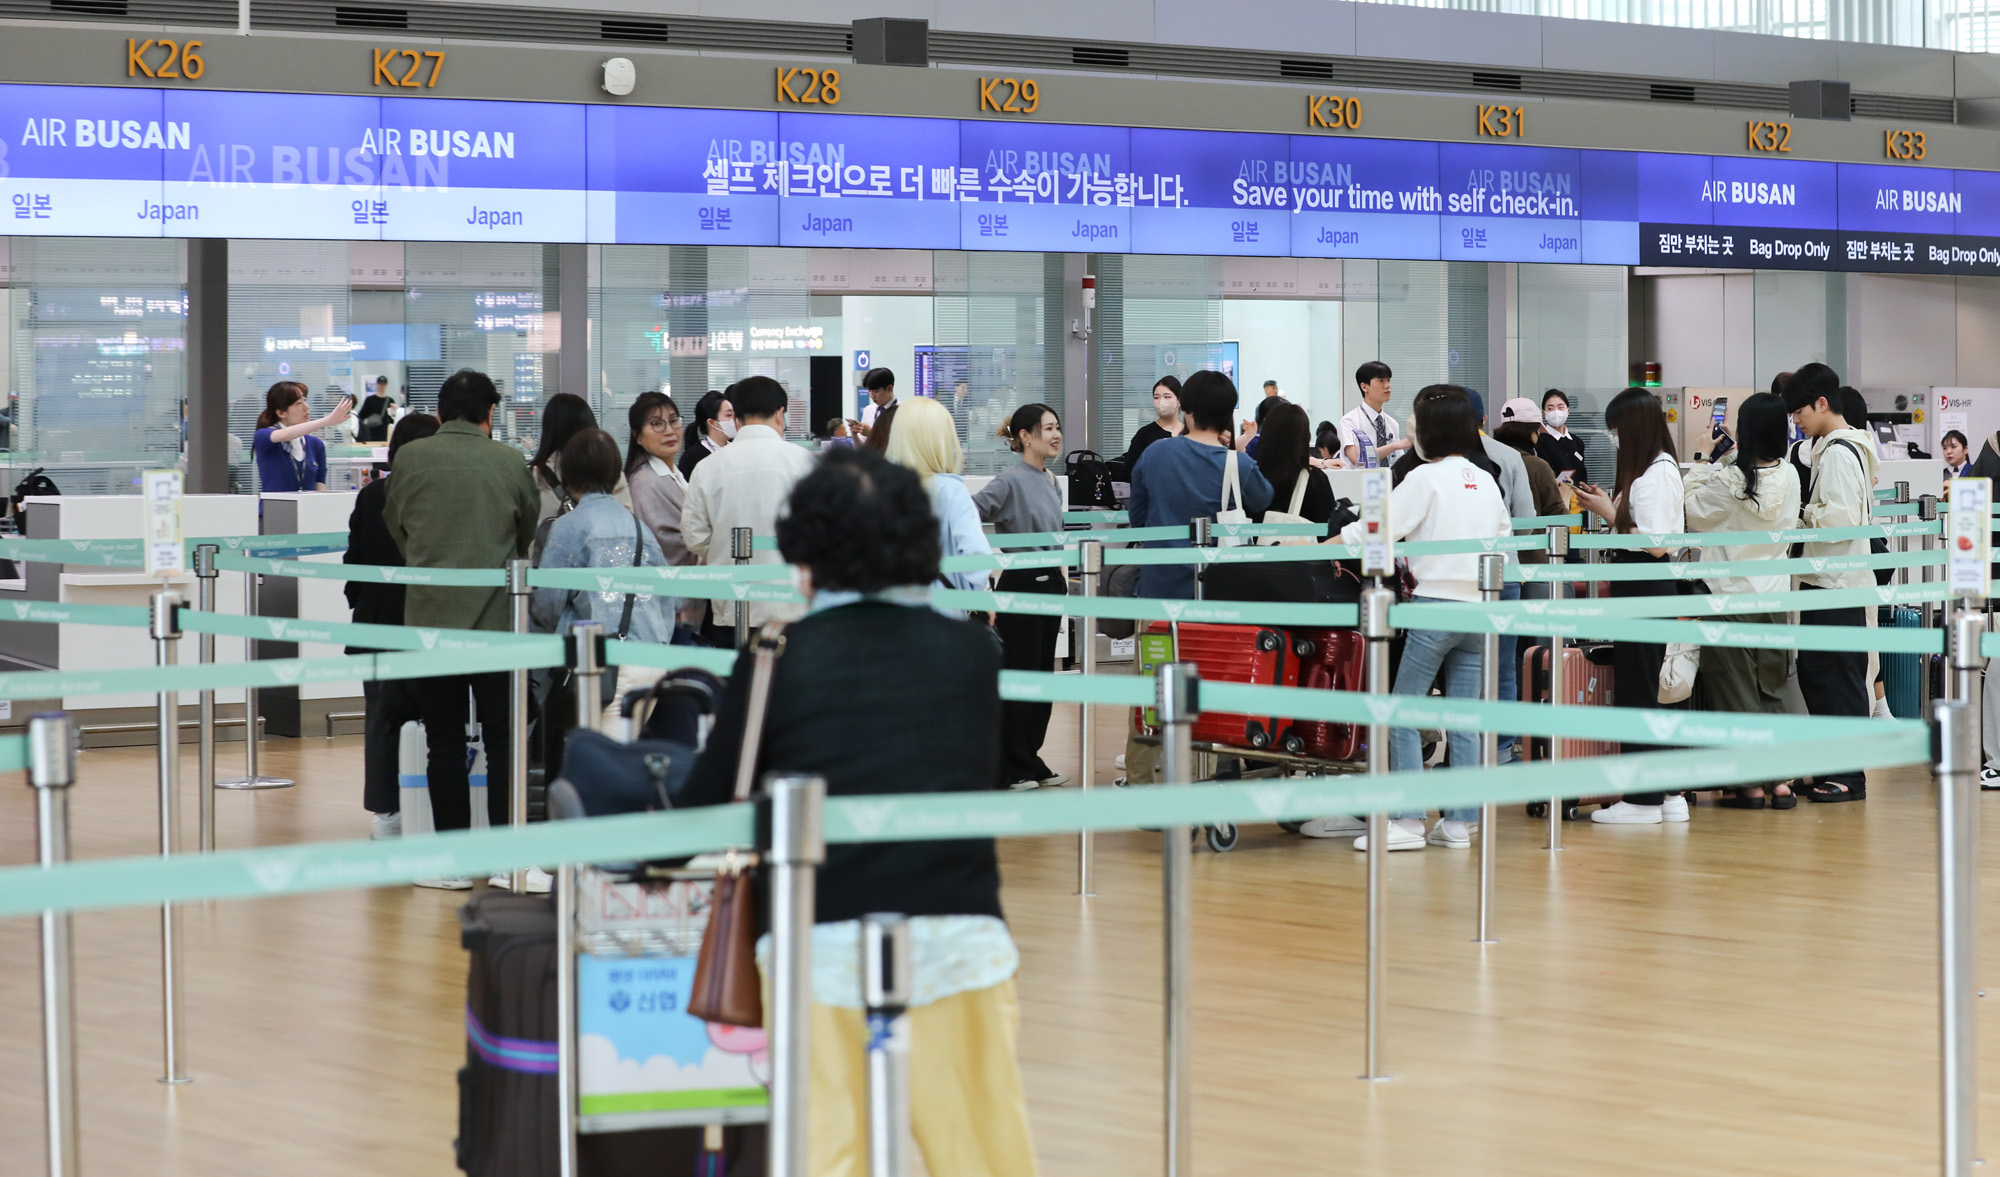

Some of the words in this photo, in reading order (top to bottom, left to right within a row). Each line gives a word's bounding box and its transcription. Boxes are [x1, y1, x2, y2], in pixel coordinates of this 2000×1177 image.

[126, 39, 205, 80] K26
[371, 48, 446, 88] K27
[776, 67, 841, 105] K28
[979, 77, 1040, 114] K29
[1307, 95, 1363, 130] K30
[1477, 104, 1525, 138] K31
[21, 117, 66, 147] AIR
[75, 119, 191, 150] BUSAN
[360, 127, 402, 156] AIR
[409, 129, 514, 158] BUSAN
[1747, 121, 1792, 154] K32
[1885, 129, 1927, 161] K33
[750, 139, 845, 168] BUSAN
[1024, 151, 1111, 177] BUSAN
[702, 159, 757, 196] 셀프
[762, 160, 894, 198] 체크인으로
[901, 164, 924, 201] 더
[932, 166, 982, 202] 빠른
[988, 168, 1060, 205] 수속이
[1067, 170, 1189, 208] 가능합니다.
[1238, 159, 1269, 184] AIR
[1274, 161, 1352, 186] BUSAN
[1467, 169, 1495, 193] AIR
[1500, 171, 1571, 195] BUSAN
[12, 193, 52, 219] 일본
[1232, 178, 1288, 208] Save
[1292, 185, 1344, 213] your
[1347, 183, 1394, 211] time
[1398, 185, 1442, 212] with
[1447, 188, 1485, 214] self
[1489, 190, 1580, 217] check-in.
[1702, 179, 1728, 204] AIR
[1732, 182, 1796, 207] BUSAN
[1875, 188, 1899, 212] AIR
[1902, 191, 1962, 214] BUSAN
[137, 200, 199, 224] Japan
[351, 200, 390, 225] 일본
[467, 206, 523, 229] Japan
[699, 207, 732, 231] 일본
[802, 214, 853, 236] Japan
[978, 214, 1009, 238] 일본
[1072, 220, 1118, 242] Japan
[1231, 220, 1259, 243] 일본
[1317, 227, 1359, 248] Japan
[1461, 227, 1488, 250] 일본
[1539, 233, 1578, 255] Japan
[1658, 234, 1682, 255] 짐만
[1685, 234, 1720, 256] 부치는
[1722, 236, 1735, 257] 곳
[1750, 239, 1770, 261] Bag
[1772, 239, 1800, 261] Drop
[1802, 241, 1830, 262] Only
[1846, 241, 1868, 261] 짐만
[1870, 242, 1901, 262] 부치는
[1903, 242, 1915, 262] 곳
[1928, 245, 1950, 265] Bag
[1951, 246, 1977, 266] Drop
[1979, 247, 2000, 267] Only
[1664, 537, 1683, 545] Incheon
[1684, 537, 1702, 546] Airport
[1783, 533, 1801, 541] Incheon
[1801, 533, 1818, 541] Airport
[1895, 527, 1912, 535] Incheon
[1913, 526, 1929, 535] Airport
